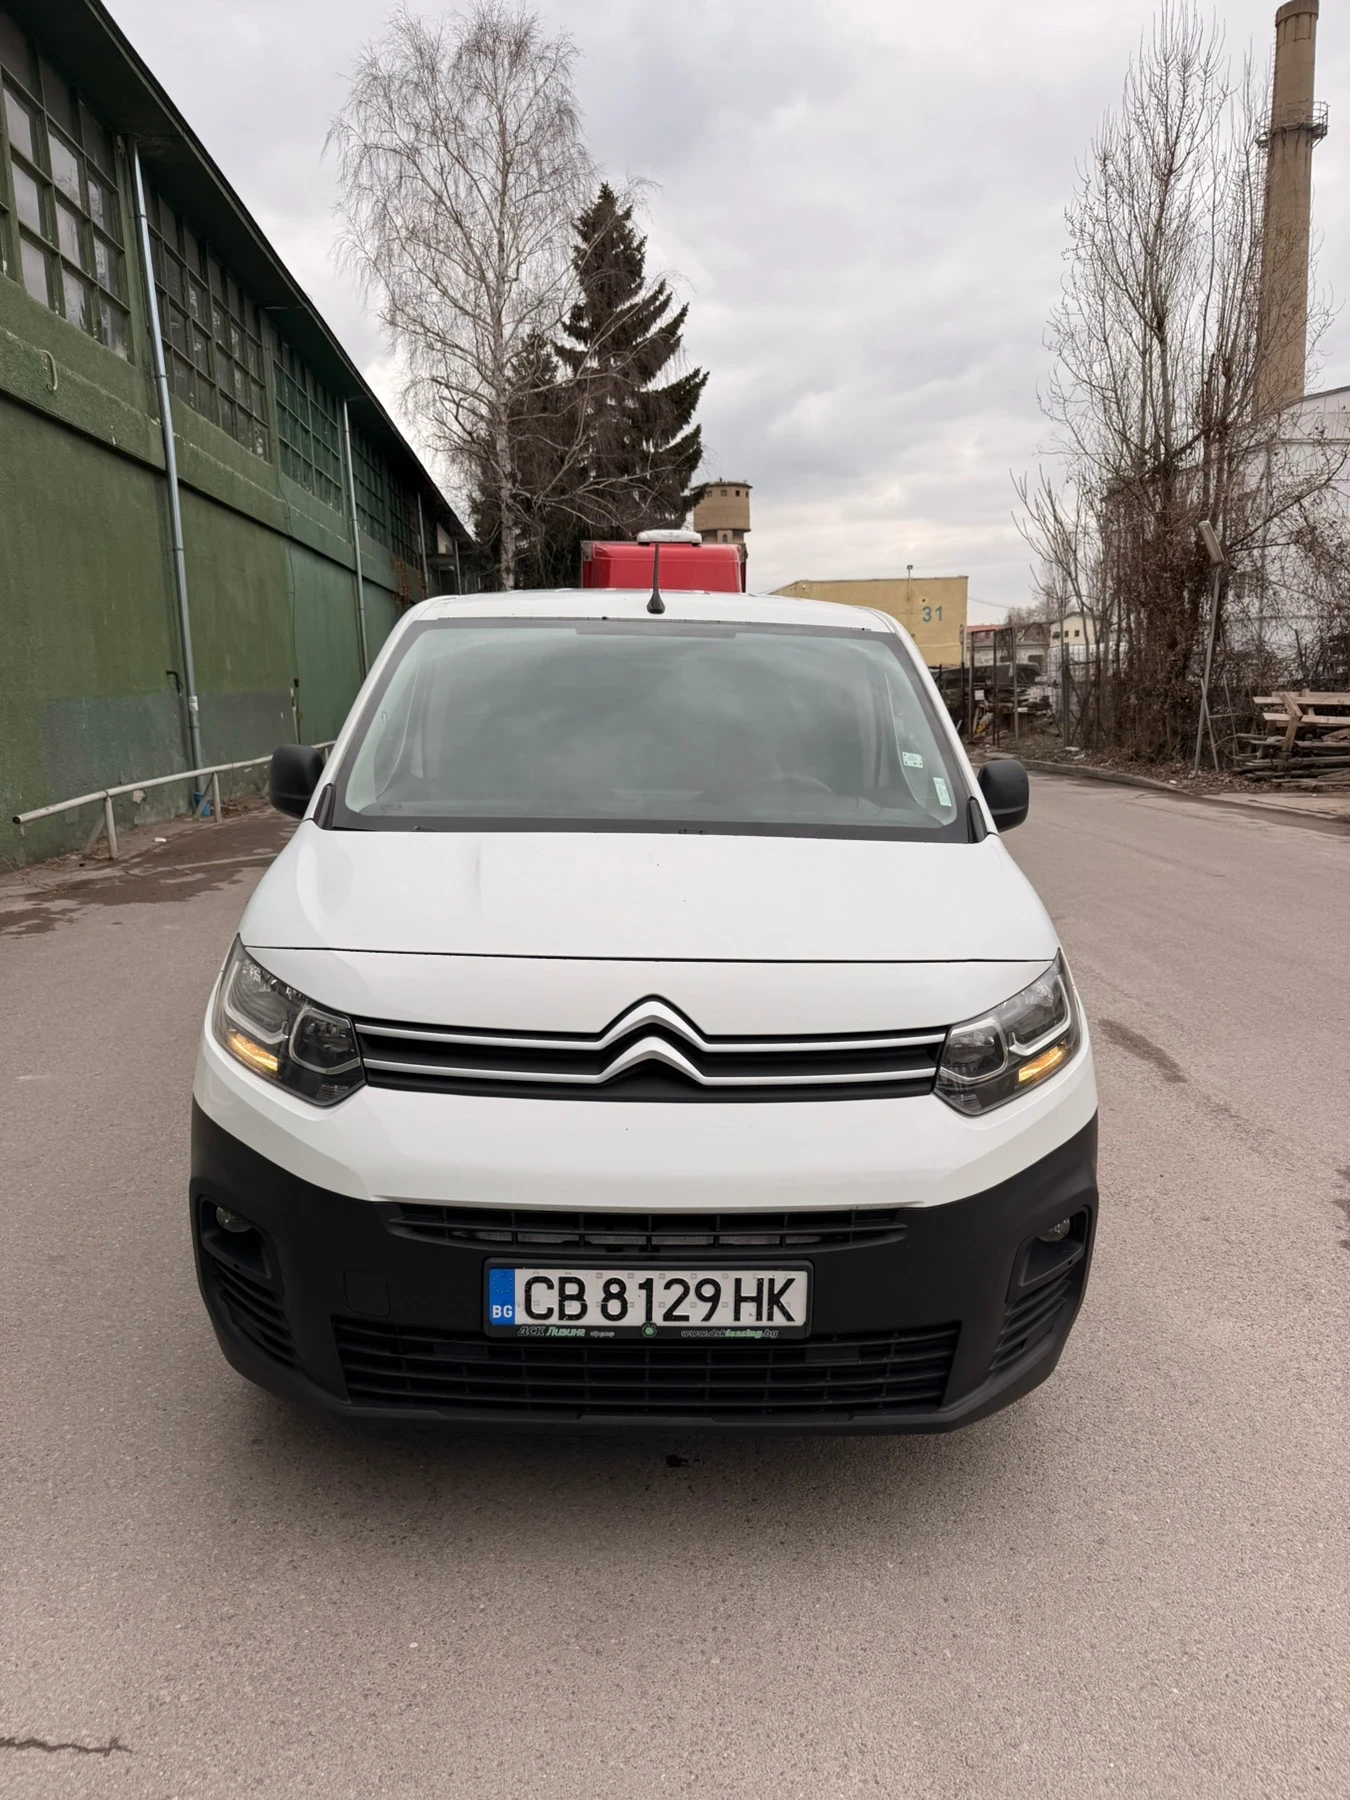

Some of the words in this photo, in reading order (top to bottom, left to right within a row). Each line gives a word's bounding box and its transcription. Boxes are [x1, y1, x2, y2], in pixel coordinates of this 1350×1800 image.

[922, 605, 943, 622] 31
[524, 1276, 588, 1320] CB
[601, 1277, 722, 1322] 8129
[733, 1277, 796, 1322] HK
[492, 1305, 513, 1318] BG
